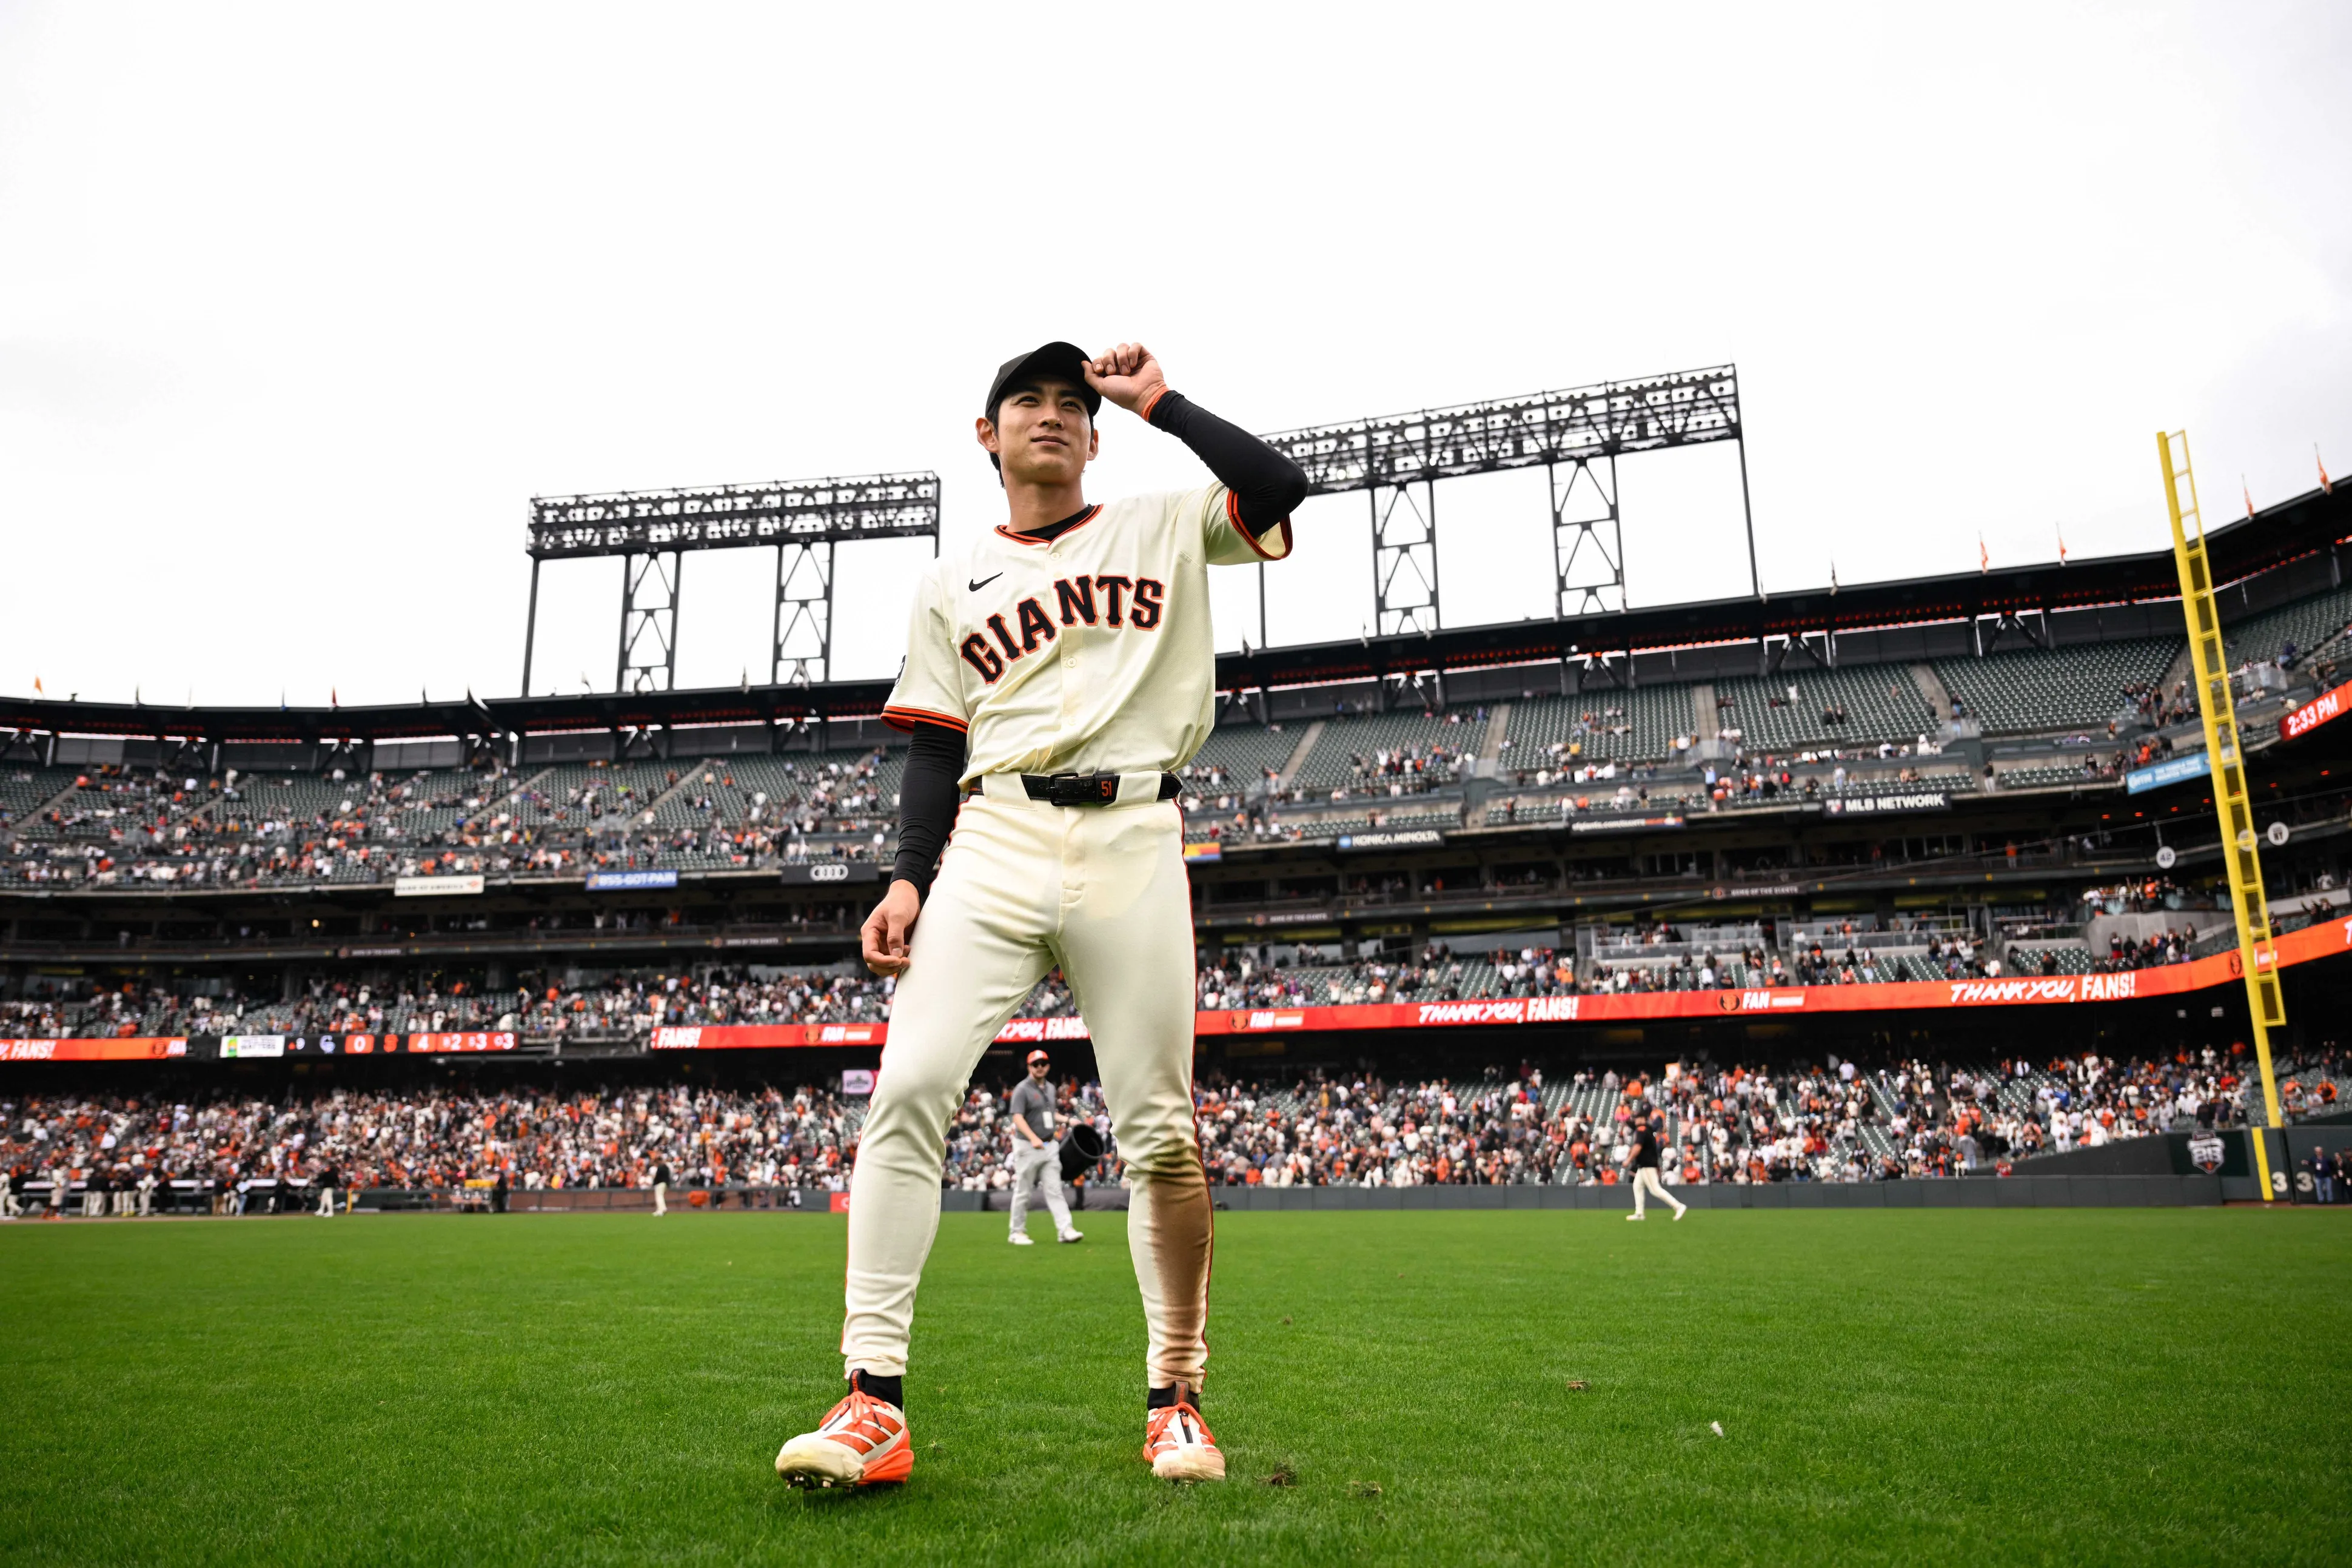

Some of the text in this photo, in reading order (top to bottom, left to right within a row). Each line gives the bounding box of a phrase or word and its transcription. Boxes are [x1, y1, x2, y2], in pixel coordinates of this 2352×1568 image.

[960, 574, 1165, 685] GIANTS
[2288, 693, 2339, 735] 2:33 PM
[1101, 780, 1112, 797] 51
[1845, 793, 1945, 812] MLB NETWORK
[1352, 830, 1440, 847] KONICA MINOLTA
[1950, 973, 2136, 1003] THANK YOU, FANS!
[1742, 991, 1770, 1010] FAN
[1250, 1011, 1275, 1028] FAN
[1419, 997, 1579, 1024] THANK YOU, FANS!
[296, 1037, 305, 1050] 9
[353, 1036, 366, 1052] 0
[417, 1035, 429, 1051] 4
[657, 1027, 702, 1048] FANS!
[821, 1026, 845, 1042] FAN
[11, 1040, 56, 1059] FANS!
